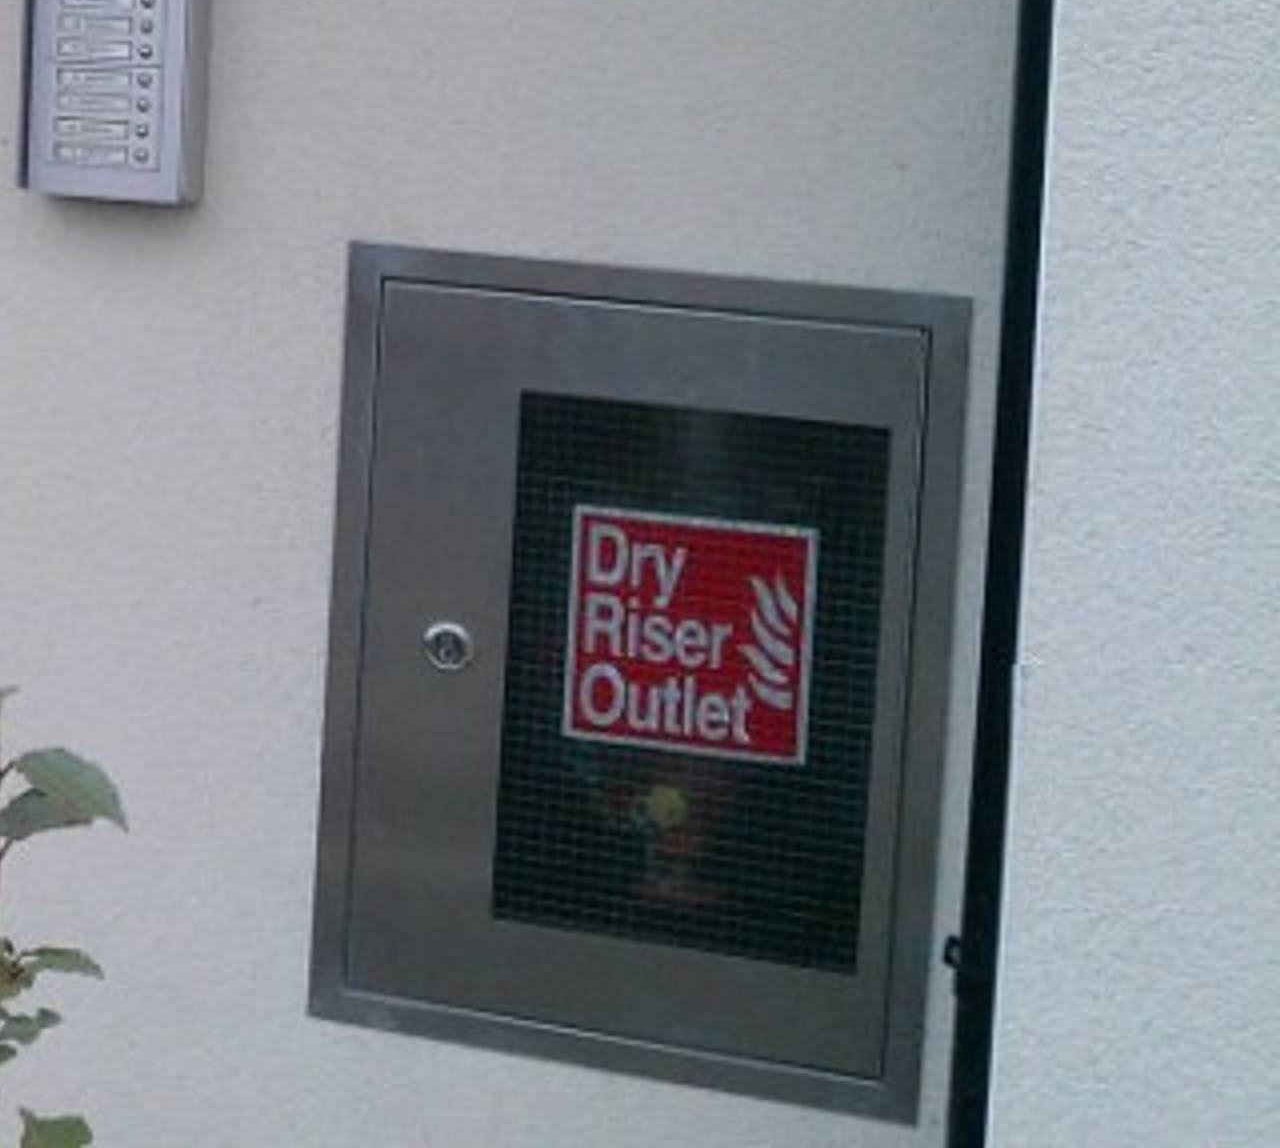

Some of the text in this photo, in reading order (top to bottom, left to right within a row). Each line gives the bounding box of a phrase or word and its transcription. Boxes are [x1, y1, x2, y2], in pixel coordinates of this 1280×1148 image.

[587, 523, 688, 607] Dry
[584, 592, 733, 669] Riser
[579, 662, 752, 742] Outlet
